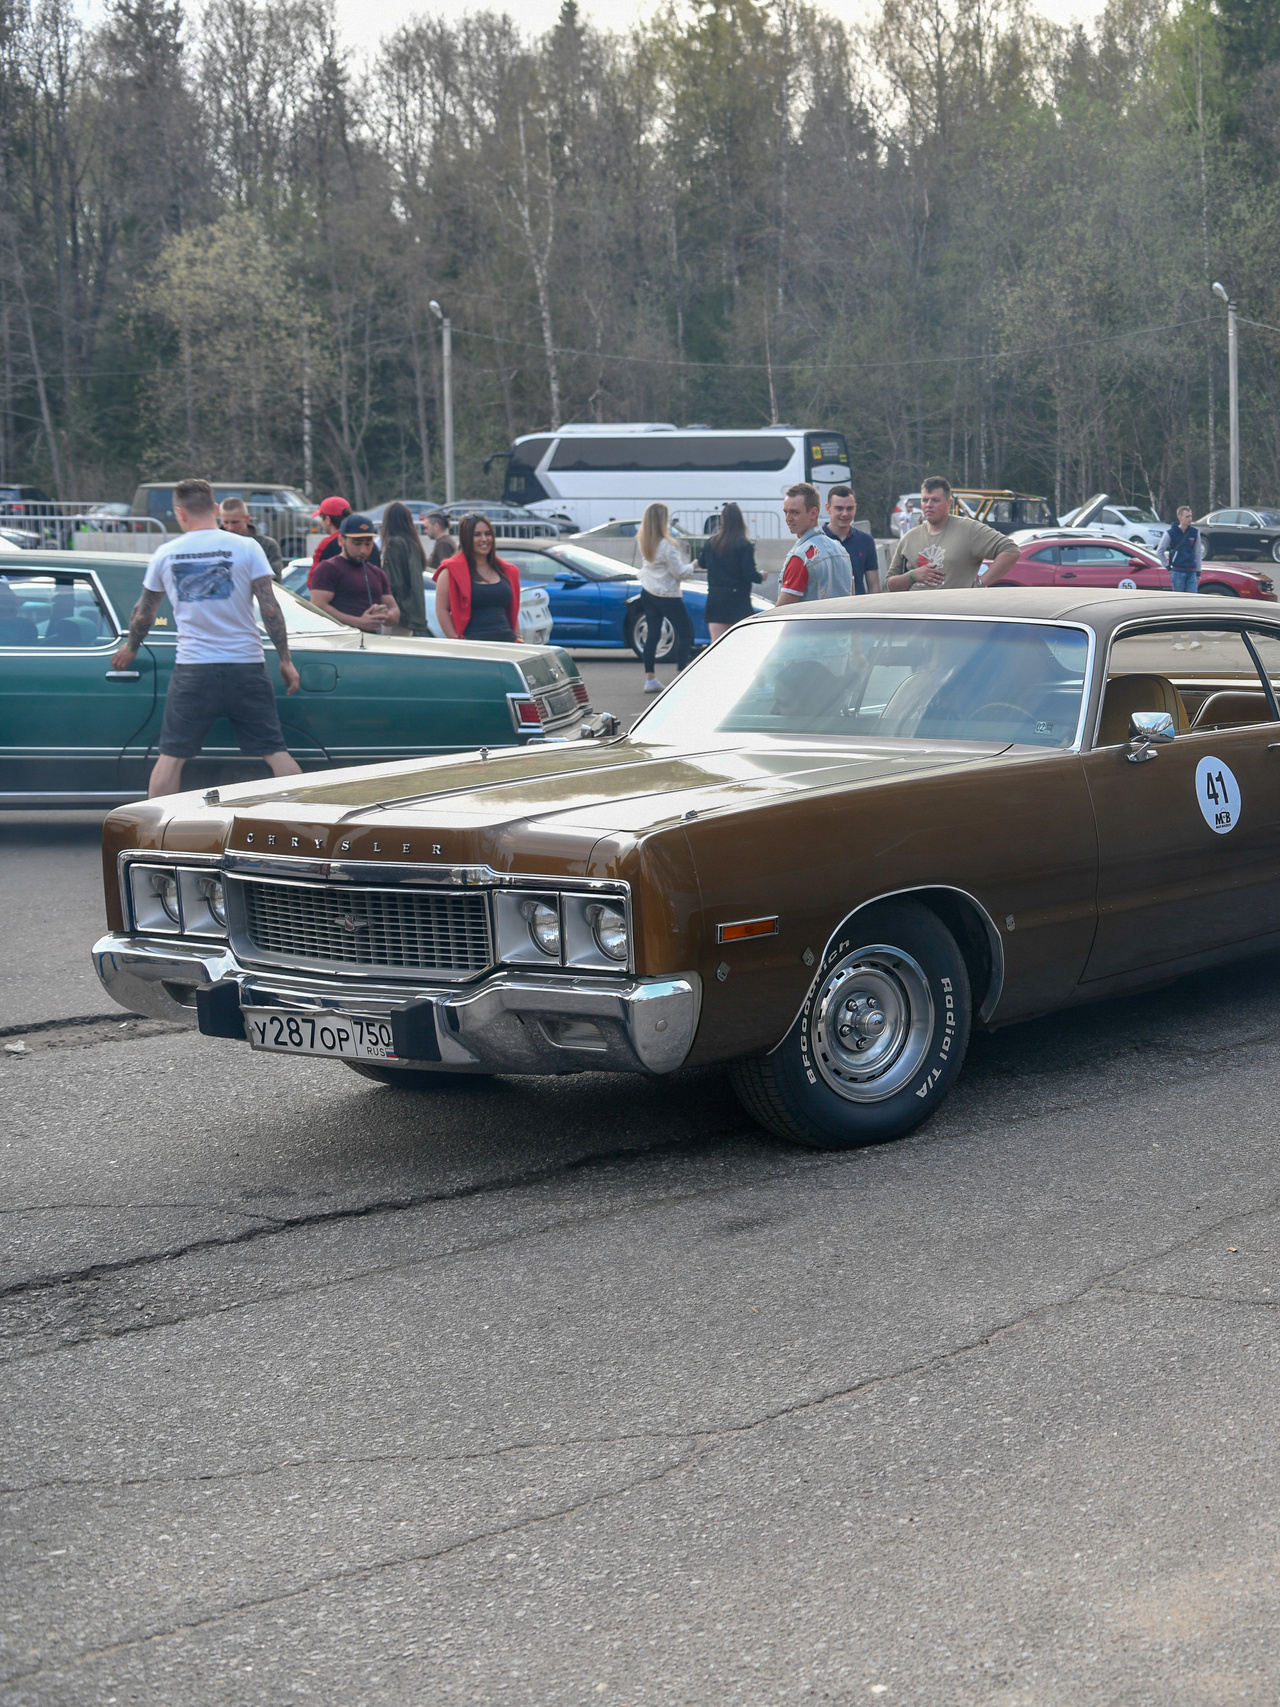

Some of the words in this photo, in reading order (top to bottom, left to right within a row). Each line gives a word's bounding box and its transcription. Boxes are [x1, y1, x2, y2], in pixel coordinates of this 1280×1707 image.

[1206, 770, 1229, 806] 41
[246, 832, 442, 856] CHRYSLER
[939, 976, 956, 1061] Radial
[353, 1021, 392, 1047] 750
[366, 1046, 386, 1057] RUS
[915, 1067, 942, 1098] T/A
